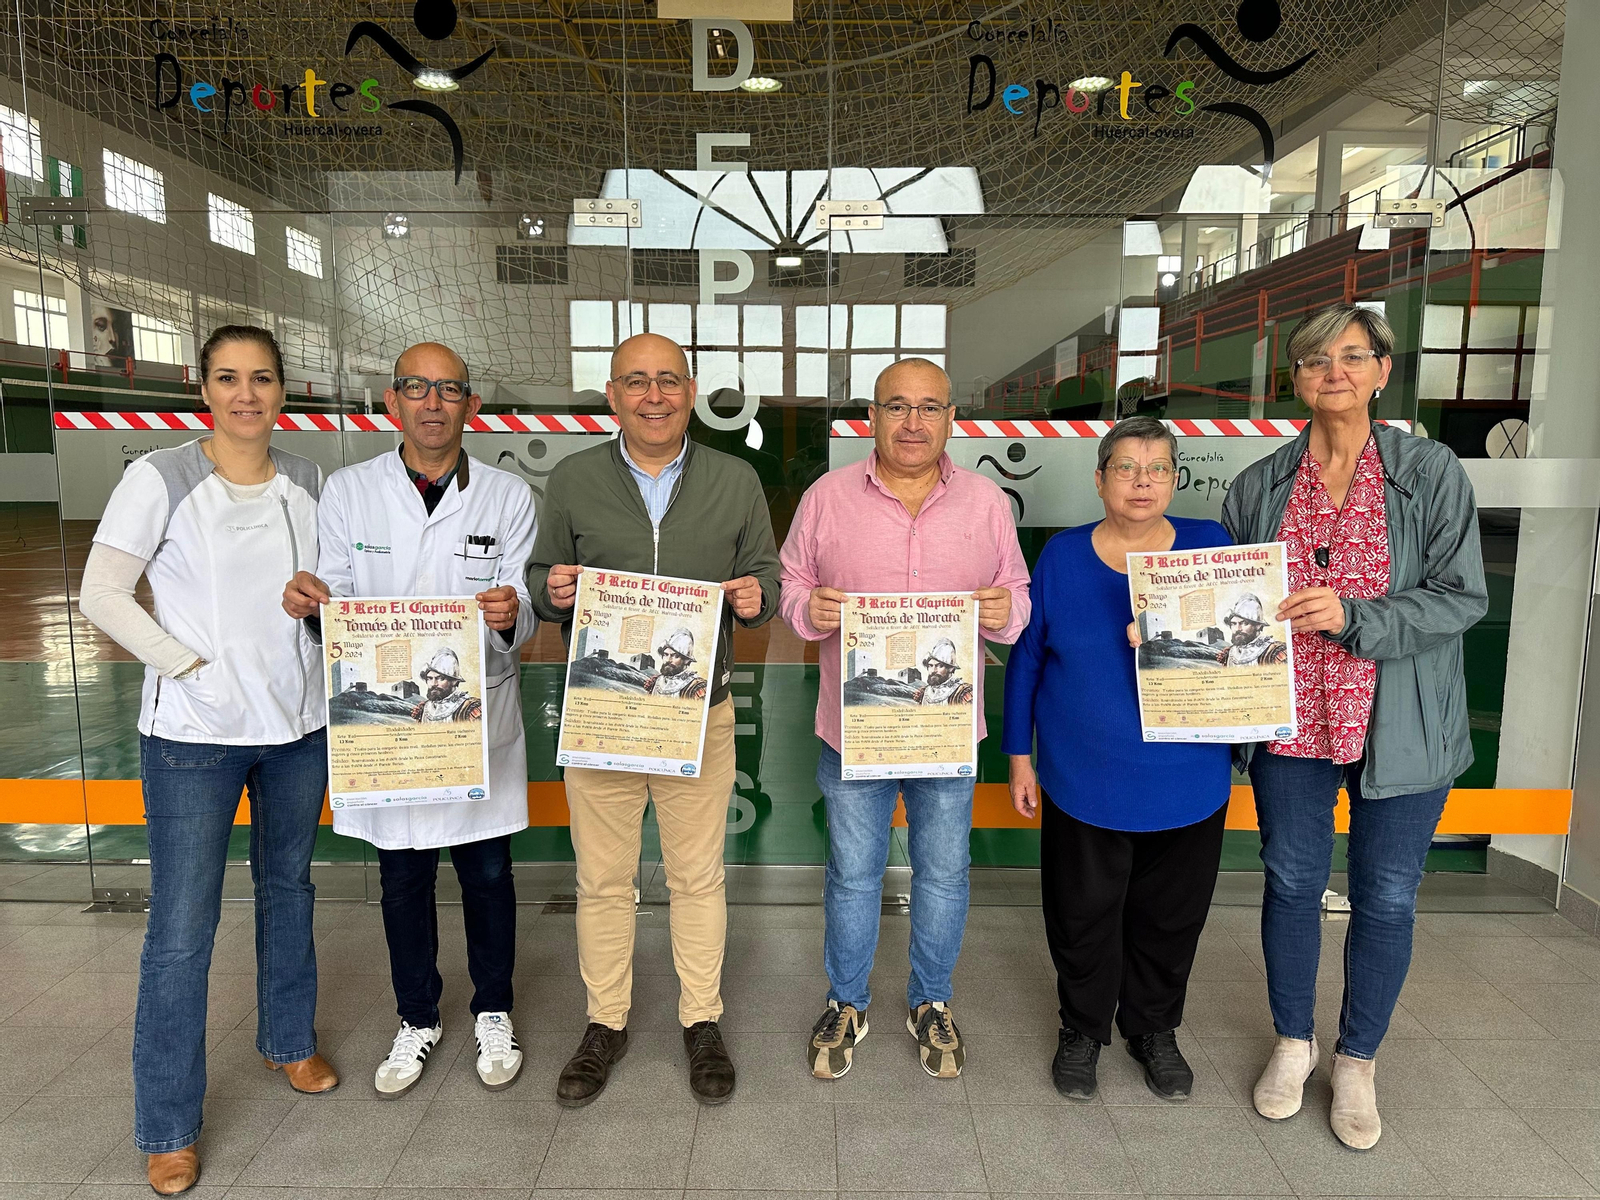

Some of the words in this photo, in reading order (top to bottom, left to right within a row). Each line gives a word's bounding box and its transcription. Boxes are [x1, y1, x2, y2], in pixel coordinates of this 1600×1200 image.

[154, 53, 381, 135] Deportes
[968, 54, 1196, 137] Deportes
[1157, 557, 1189, 568] Reto
[1192, 554, 1208, 565] El
[1211, 548, 1268, 564] Capitán
[609, 575, 638, 589] Reto
[641, 579, 655, 591] El
[658, 582, 708, 598] Capitán
[354, 602, 386, 614] Reto
[390, 602, 406, 614] El
[409, 601, 465, 615] Capitán
[1137, 594, 1148, 609] 5
[580, 609, 592, 625] 5
[594, 610, 612, 619] Mayo
[593, 619, 609, 627] 2024
[330, 642, 342, 658] 5
[343, 641, 363, 649] Mayo
